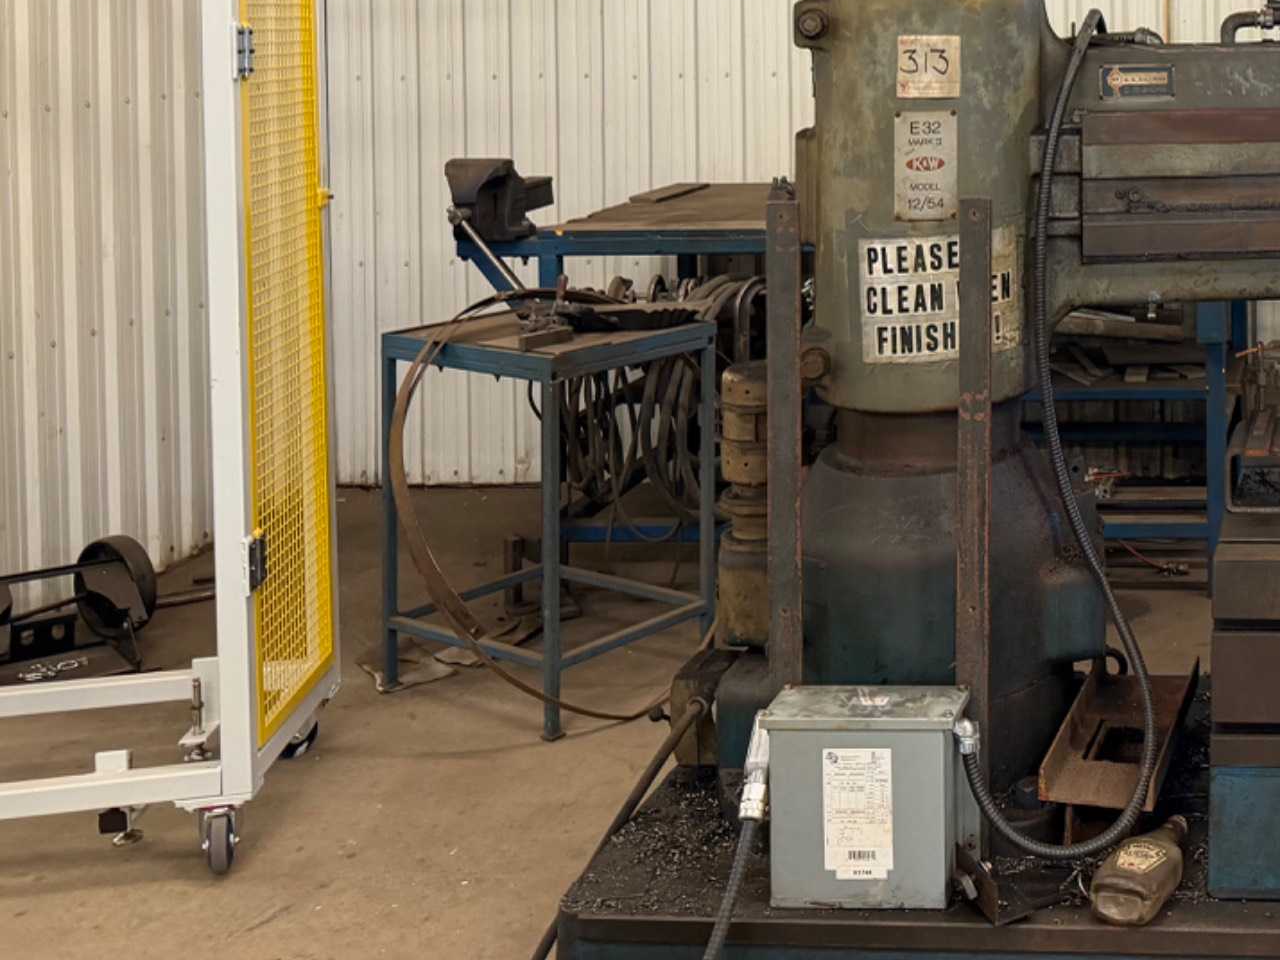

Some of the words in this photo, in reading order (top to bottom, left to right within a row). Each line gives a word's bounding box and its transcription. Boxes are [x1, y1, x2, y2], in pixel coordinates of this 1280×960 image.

[900, 48, 949, 75] 313
[910, 120, 942, 135] E32
[910, 183, 941, 192] MODEL
[908, 197, 944, 212] 12/54
[867, 241, 960, 275] PLEASE
[866, 283, 944, 315] CLEAN
